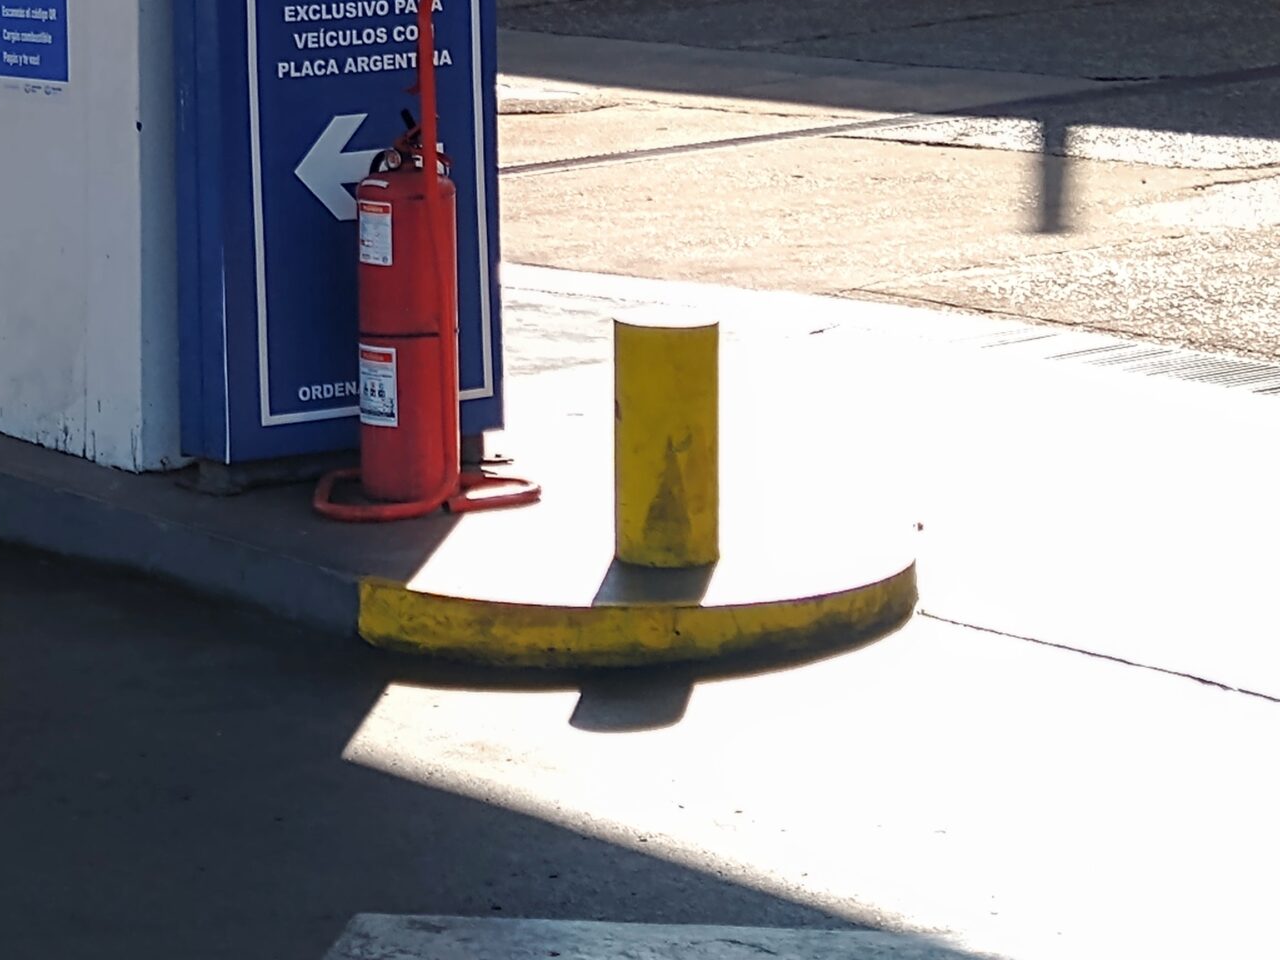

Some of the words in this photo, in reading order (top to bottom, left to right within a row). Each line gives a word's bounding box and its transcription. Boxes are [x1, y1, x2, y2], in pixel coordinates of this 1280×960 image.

[283, 0, 389, 23] EXCLUSIVO
[294, 26, 388, 50] VEÍCULOS
[393, 24, 435, 43] CO
[277, 60, 340, 79] PLACA
[344, 49, 453, 74] ARGENTA
[299, 381, 360, 401] ORDEN
